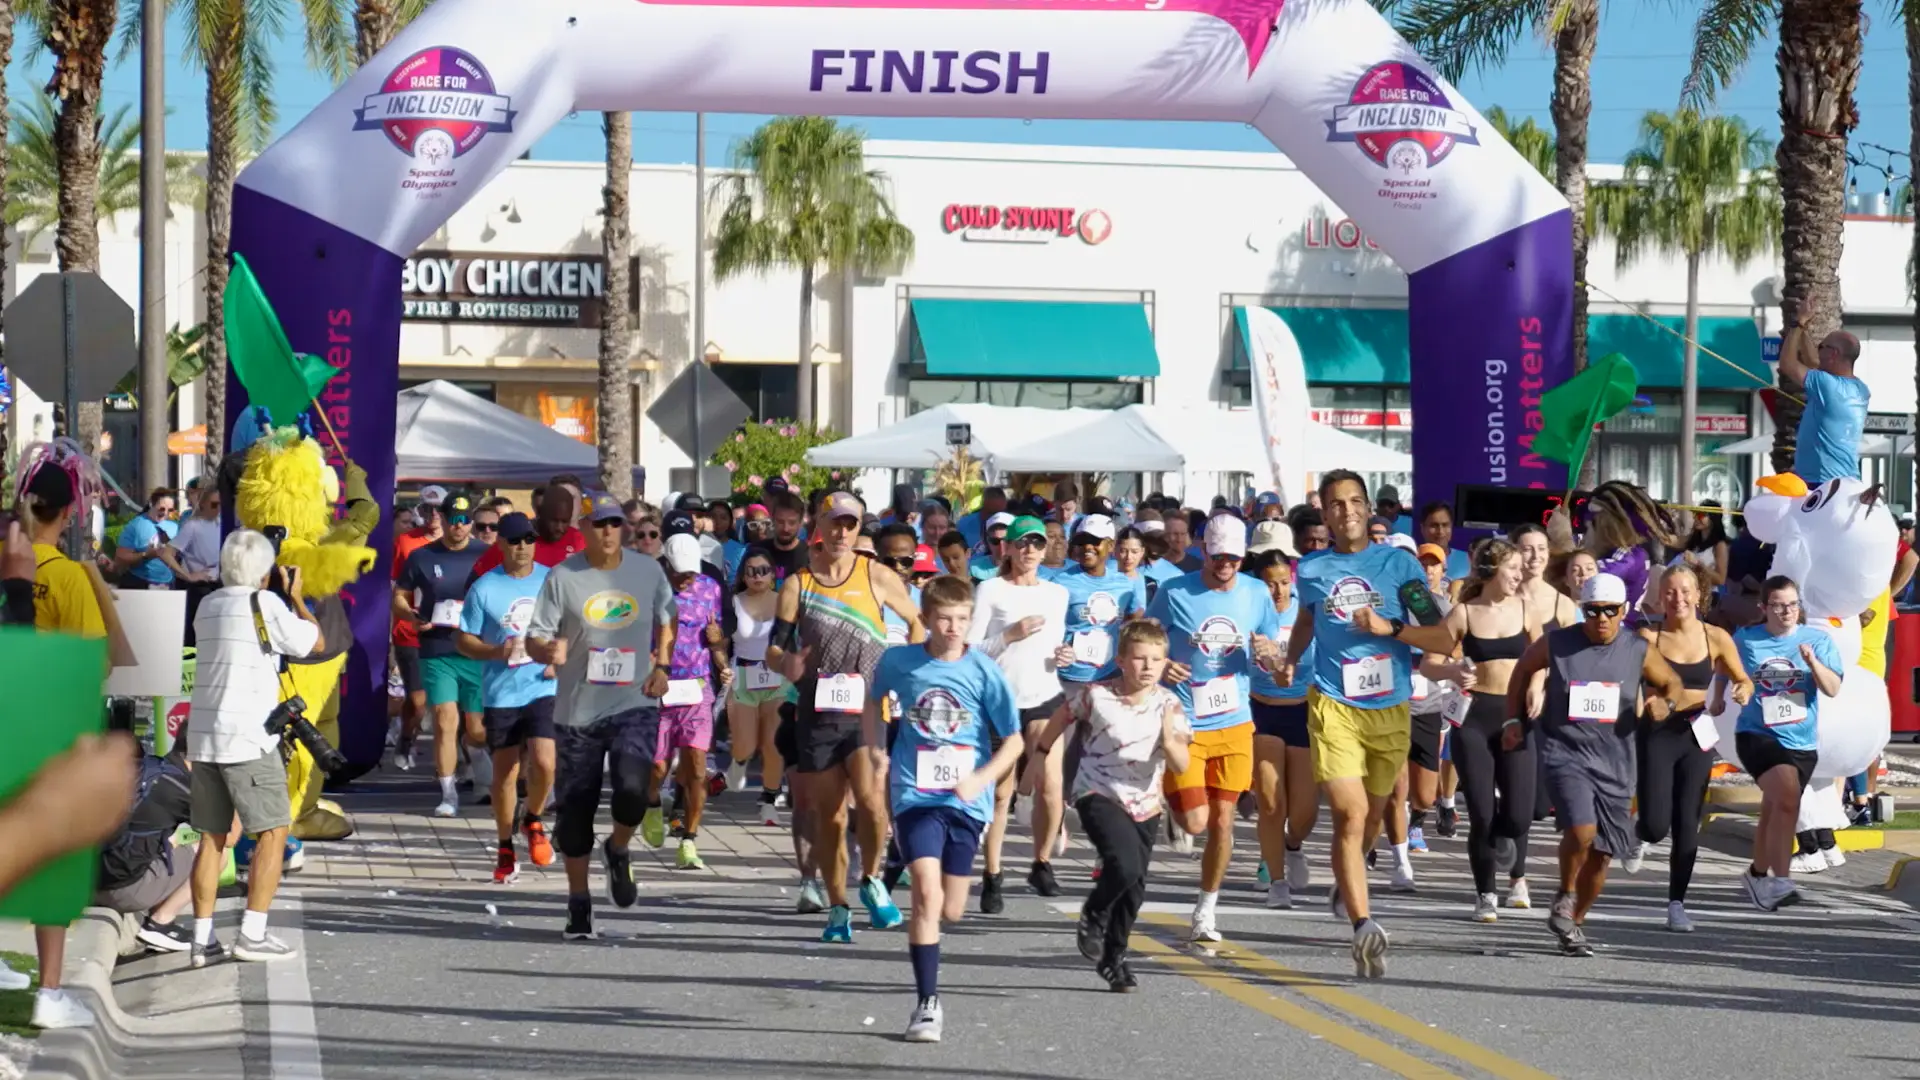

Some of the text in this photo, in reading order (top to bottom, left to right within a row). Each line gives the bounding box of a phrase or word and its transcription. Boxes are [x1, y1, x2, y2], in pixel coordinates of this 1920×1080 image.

[810, 49, 1050, 95] FINISH
[410, 75, 467, 89] RACE FOR
[1379, 88, 1430, 102] RACE FOR
[386, 95, 484, 117] INCLUSION
[1357, 107, 1447, 128] INCLUSION
[408, 168, 456, 179] Special
[401, 180, 458, 190] Olympics
[1383, 179, 1431, 188] Special
[1377, 189, 1437, 200] Olympics
[942, 203, 1001, 233] COLD
[1003, 205, 1077, 237] STONE
[401, 257, 602, 297] BOY CHICKEN
[404, 300, 579, 319] FIRE ROTISSERIE
[1321, 411, 1368, 429] Liquor
[1484, 359, 1508, 484] usion.org
[1711, 417, 1746, 433] Spirits
[1864, 417, 1908, 428] ONE WAY
[602, 662, 623, 677] 167
[1358, 673, 1382, 690] 244
[831, 689, 851, 703] 168
[1208, 694, 1228, 708] 184
[1583, 698, 1605, 713] 366
[1778, 704, 1792, 718] 29
[933, 765, 960, 782] 284
